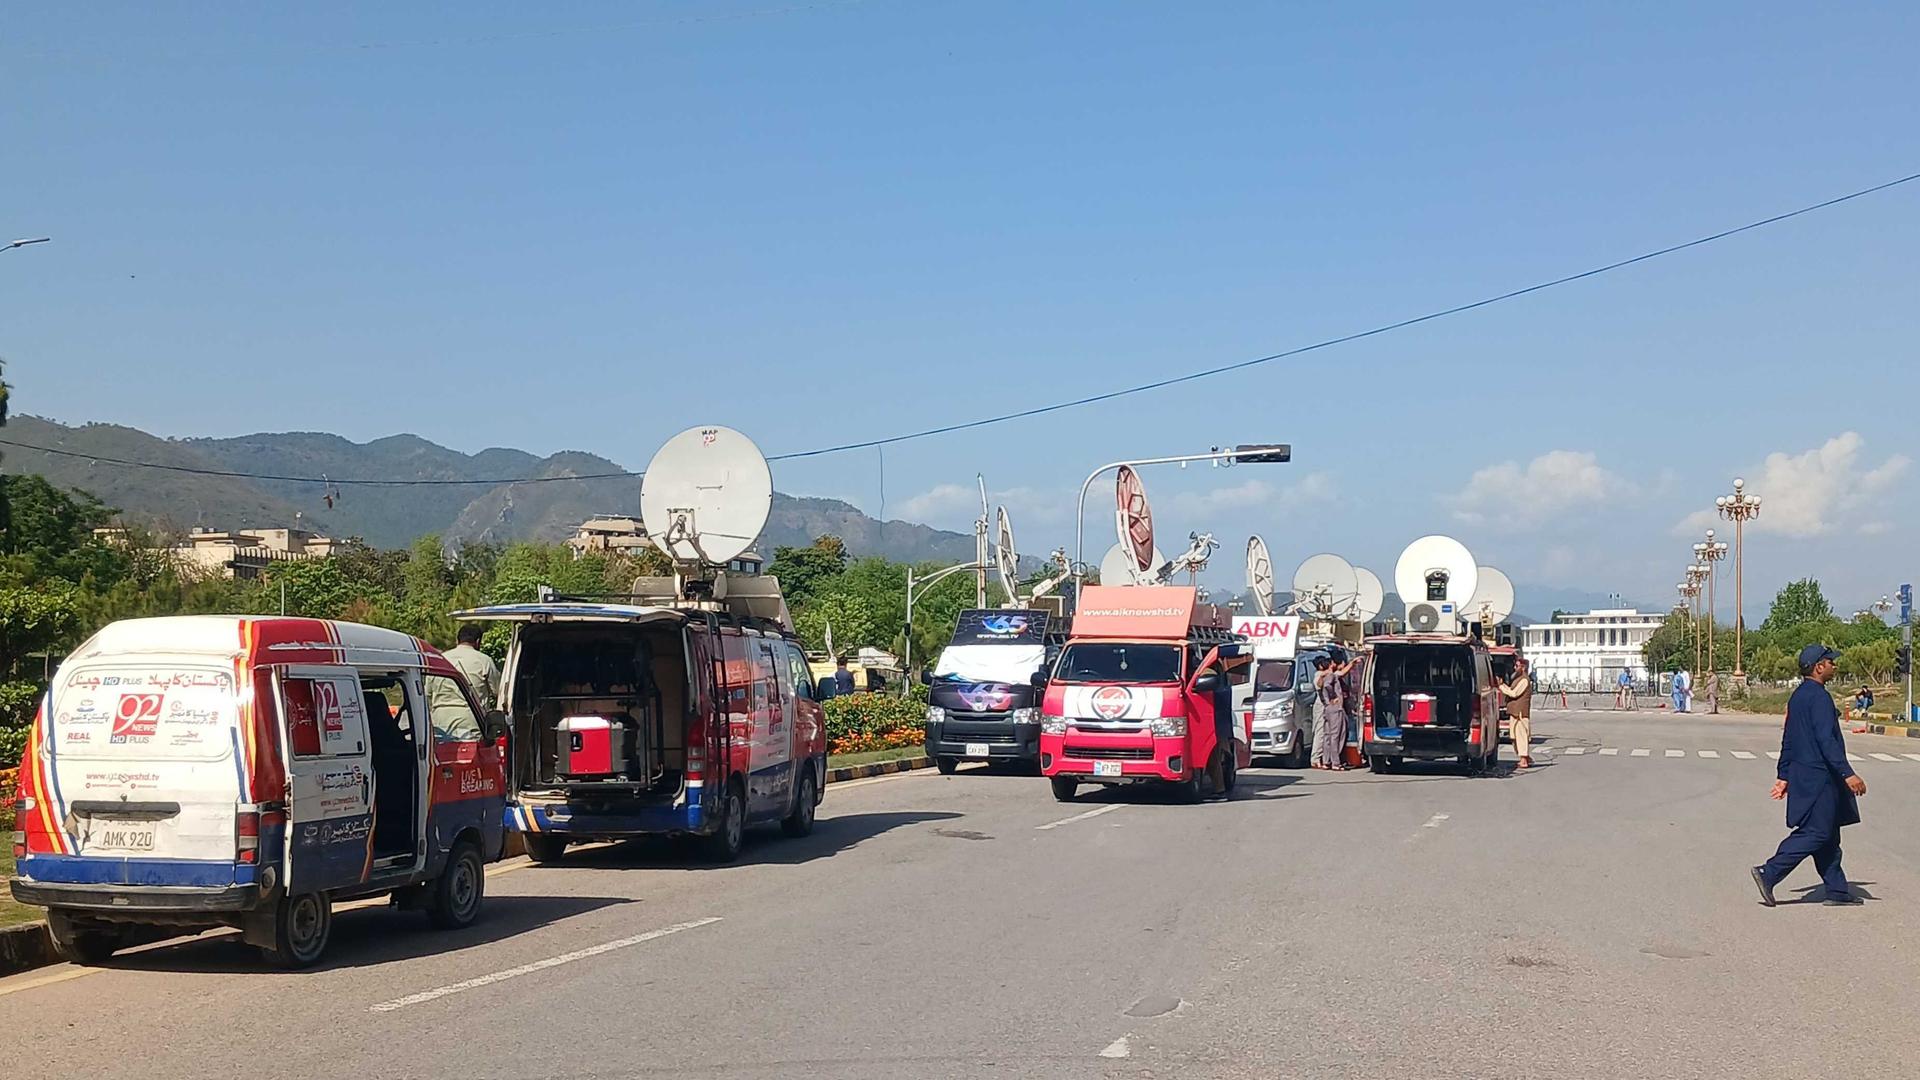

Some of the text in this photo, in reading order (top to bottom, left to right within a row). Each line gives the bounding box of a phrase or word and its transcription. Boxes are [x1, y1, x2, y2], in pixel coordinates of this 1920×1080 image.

[1237, 621, 1290, 637] ABN
[103, 677, 120, 685] HD
[122, 677, 142, 685] PLUS
[112, 694, 160, 734] 92
[132, 724, 157, 732] NEWS
[67, 732, 91, 740] REAL
[111, 735, 126, 743] HD
[461, 769, 477, 782] LIVE
[103, 831, 152, 847] AMK 920
